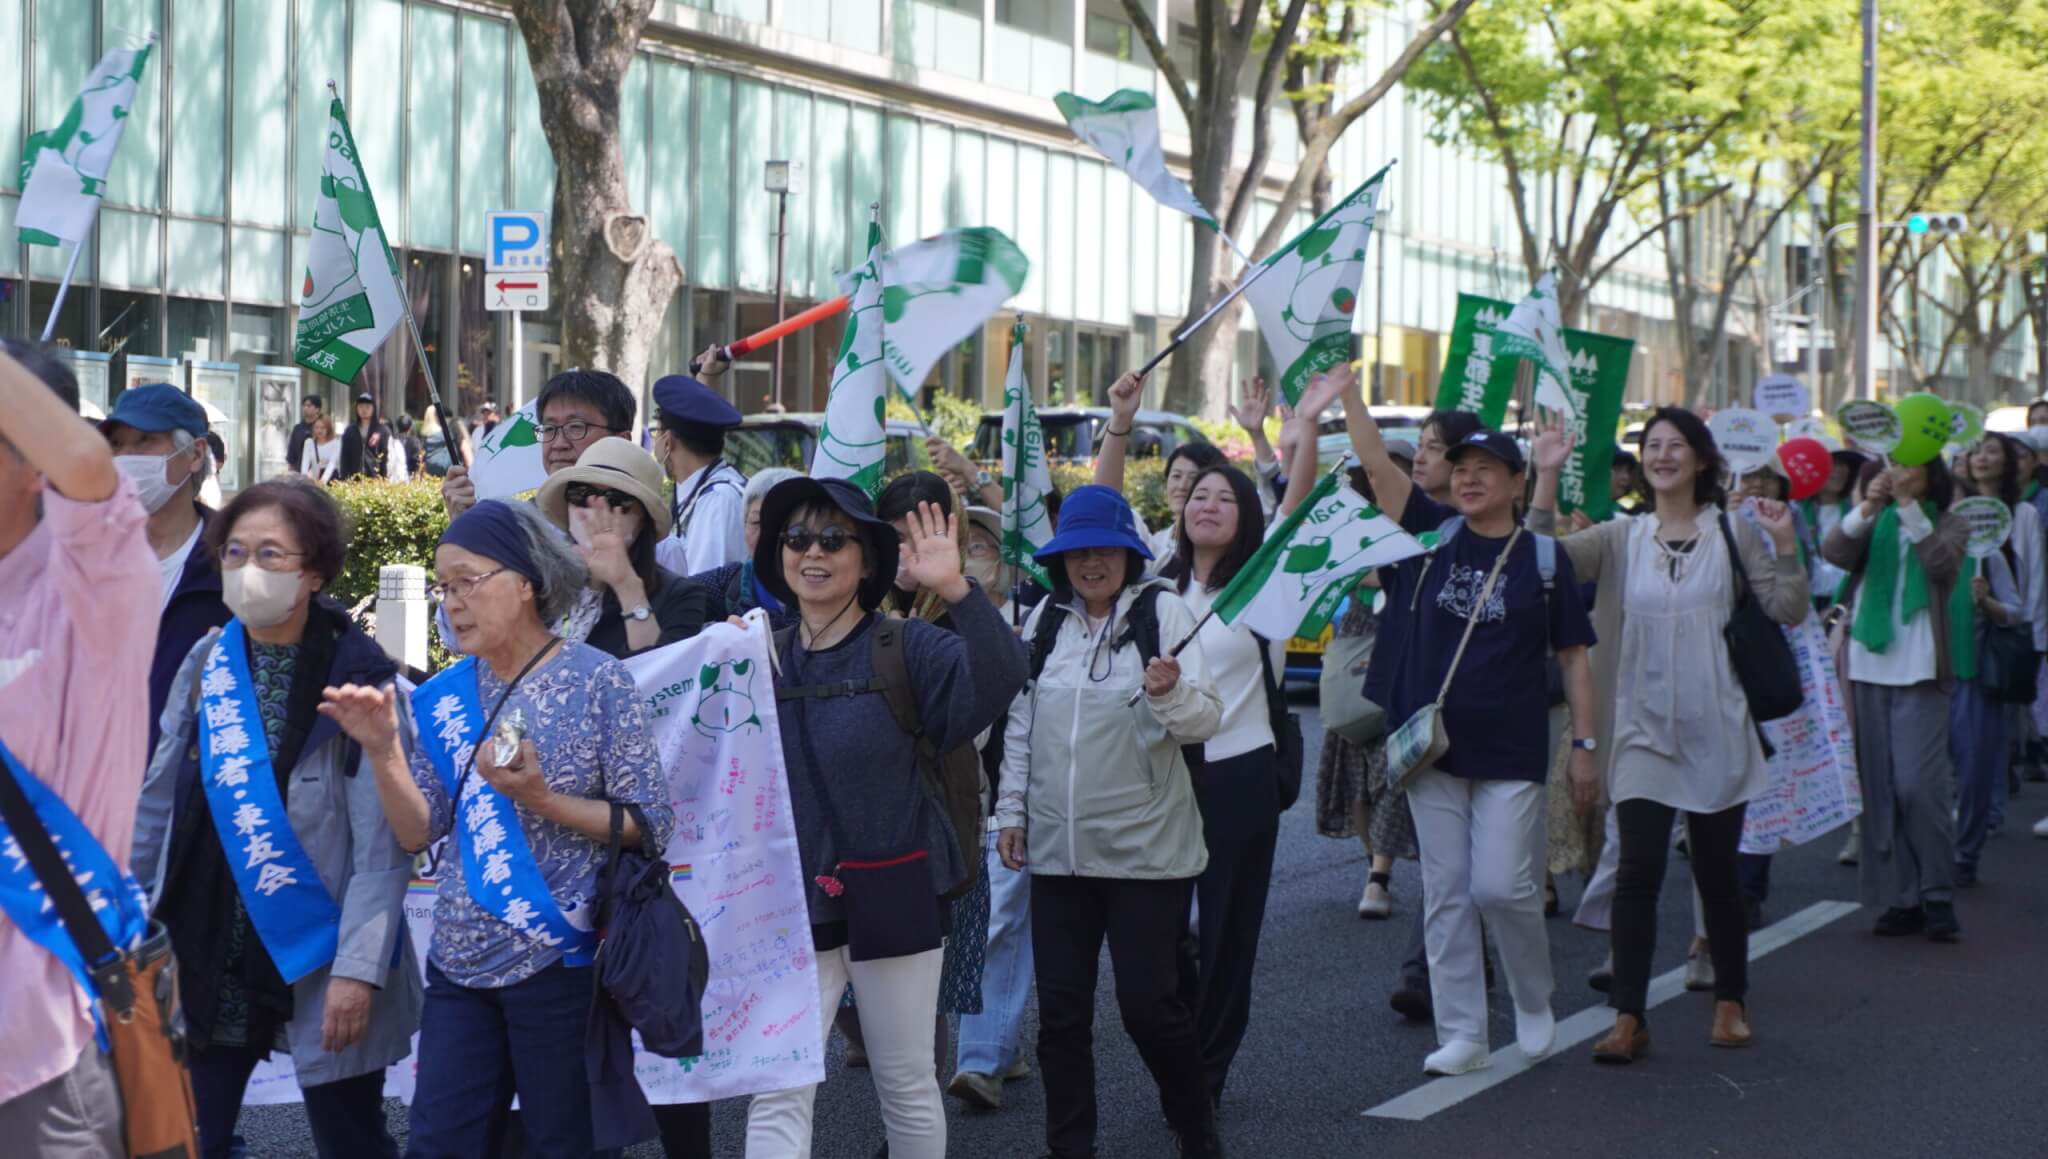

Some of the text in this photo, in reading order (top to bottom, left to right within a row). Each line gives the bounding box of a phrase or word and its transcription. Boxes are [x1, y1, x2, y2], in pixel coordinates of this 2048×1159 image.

[493, 216, 540, 266] P
[495, 295, 538, 306] 入口
[1458, 332, 1497, 412] 東都生
